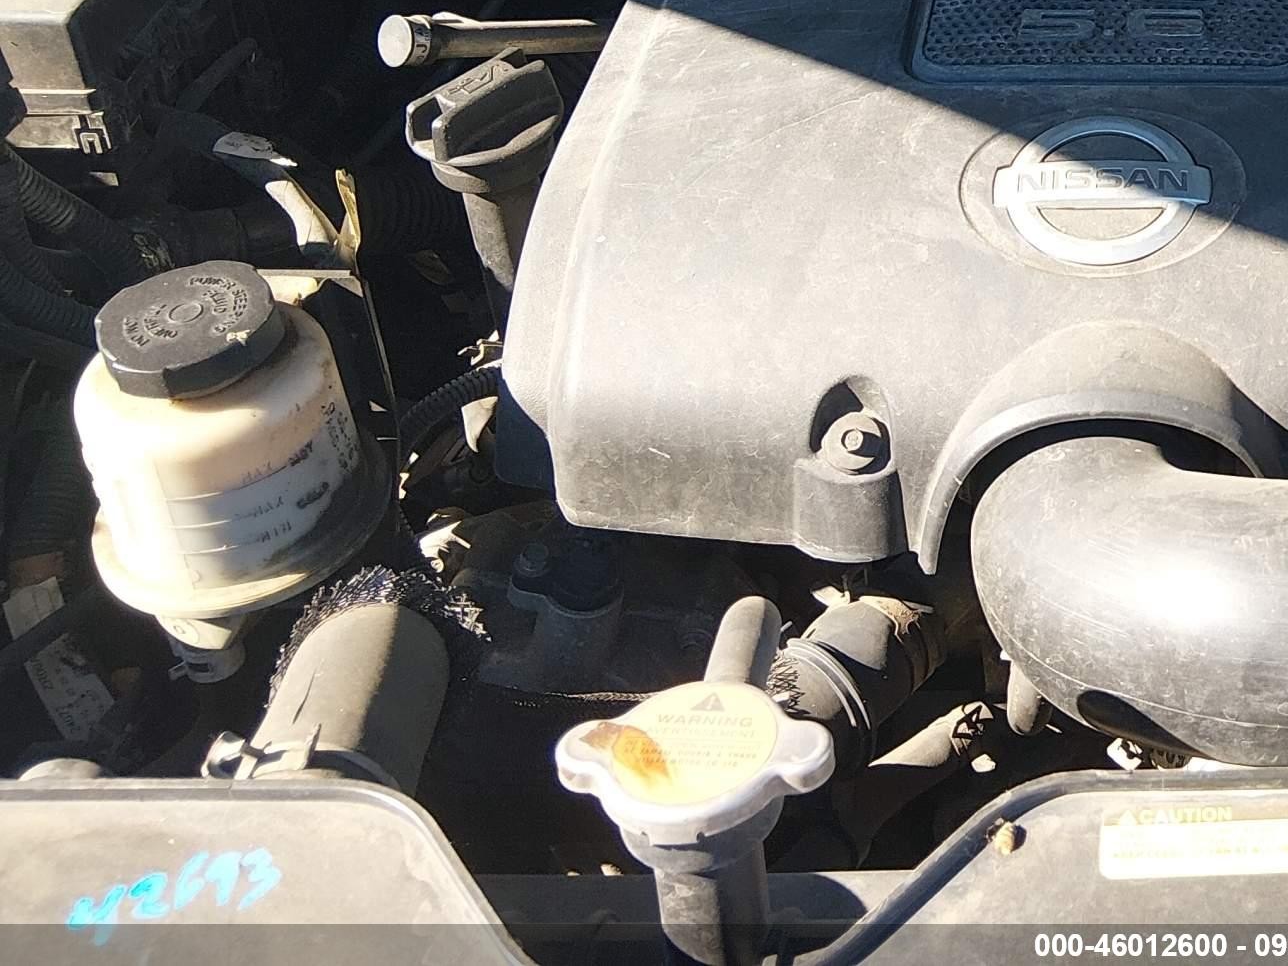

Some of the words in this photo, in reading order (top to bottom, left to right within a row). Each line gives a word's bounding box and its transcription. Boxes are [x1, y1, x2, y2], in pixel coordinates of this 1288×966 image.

[1019, 8, 1204, 37] 5.6
[1016, 168, 1189, 192] NISSAN
[656, 713, 753, 728] WARNING
[1138, 805, 1233, 824] CAUTION
